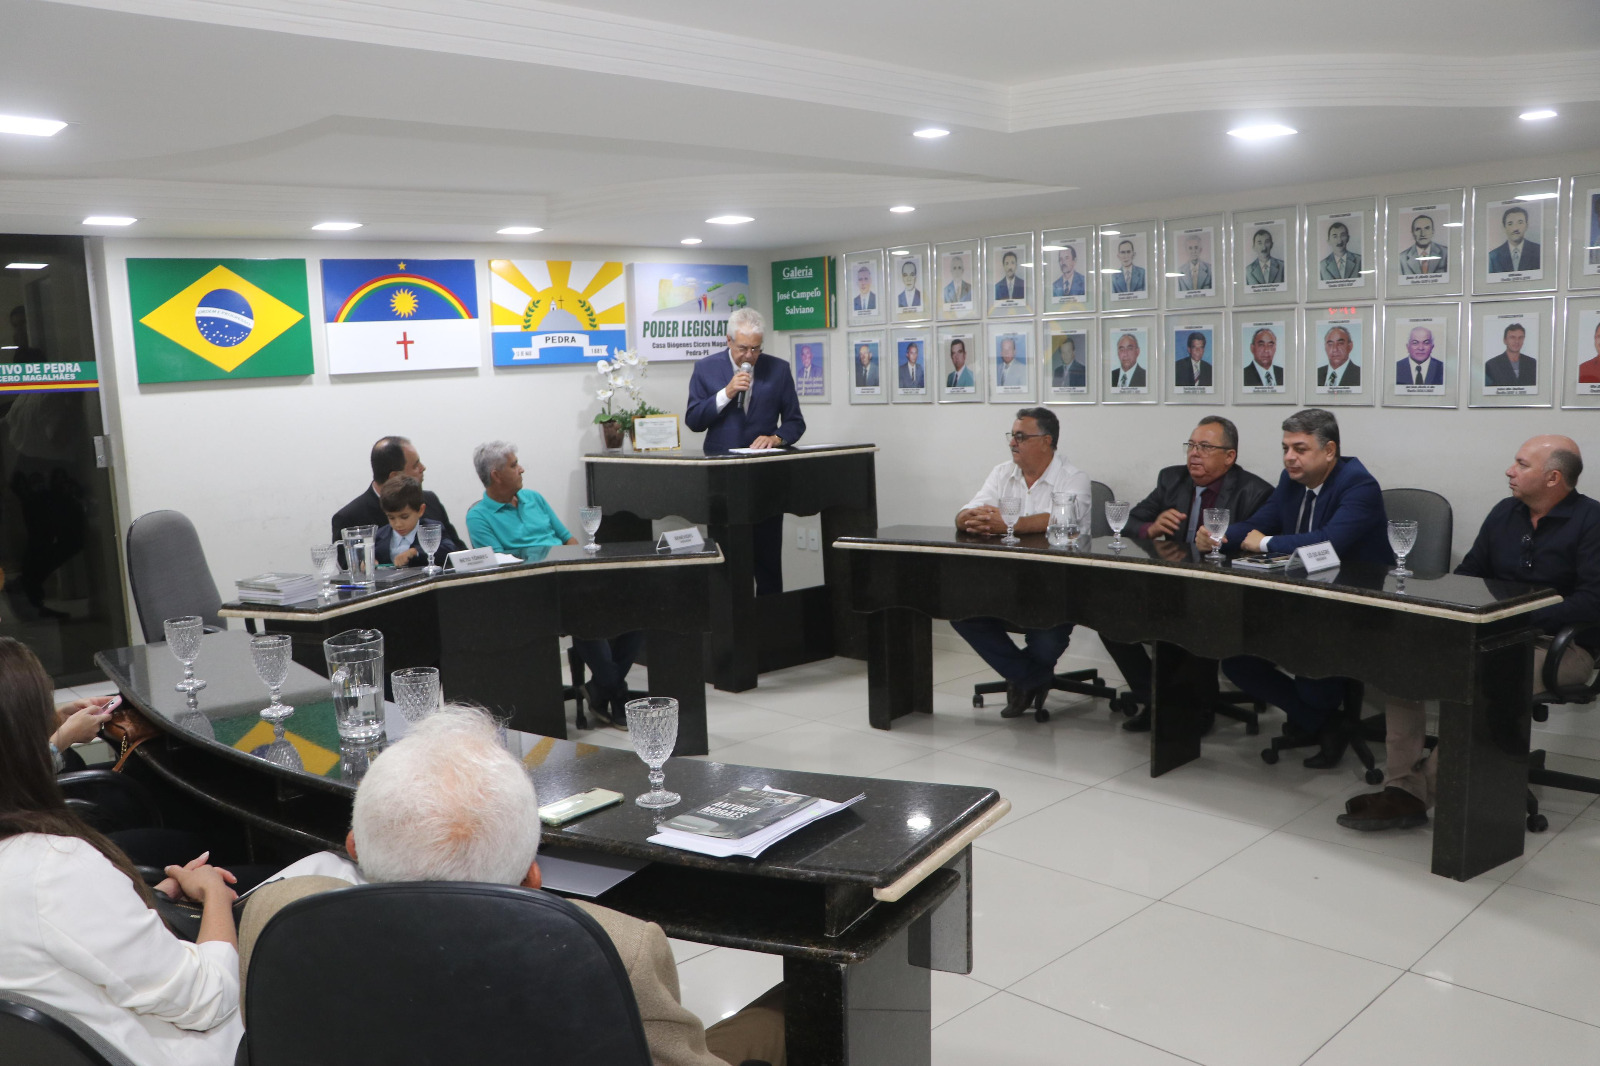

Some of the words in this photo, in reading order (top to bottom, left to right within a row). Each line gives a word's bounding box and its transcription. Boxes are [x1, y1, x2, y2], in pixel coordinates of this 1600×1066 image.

[782, 266, 813, 279] Galeria
[777, 291, 790, 302] José
[791, 287, 821, 300] Campelo
[785, 305, 814, 315] Salviano
[642, 320, 679, 338] PODER
[681, 319, 729, 337] LEGISLAT
[545, 335, 577, 344] PEDRA
[667, 341, 693, 350] Diógenes
[711, 340, 728, 348] Magal
[0, 364, 23, 375] IVO
[25, 364, 41, 374] DE
[43, 362, 82, 374] PEDRA
[22, 373, 76, 382] MAGALHÃES
[700, 806, 748, 819] MORAES
[710, 801, 761, 814] ANTÔNIO
